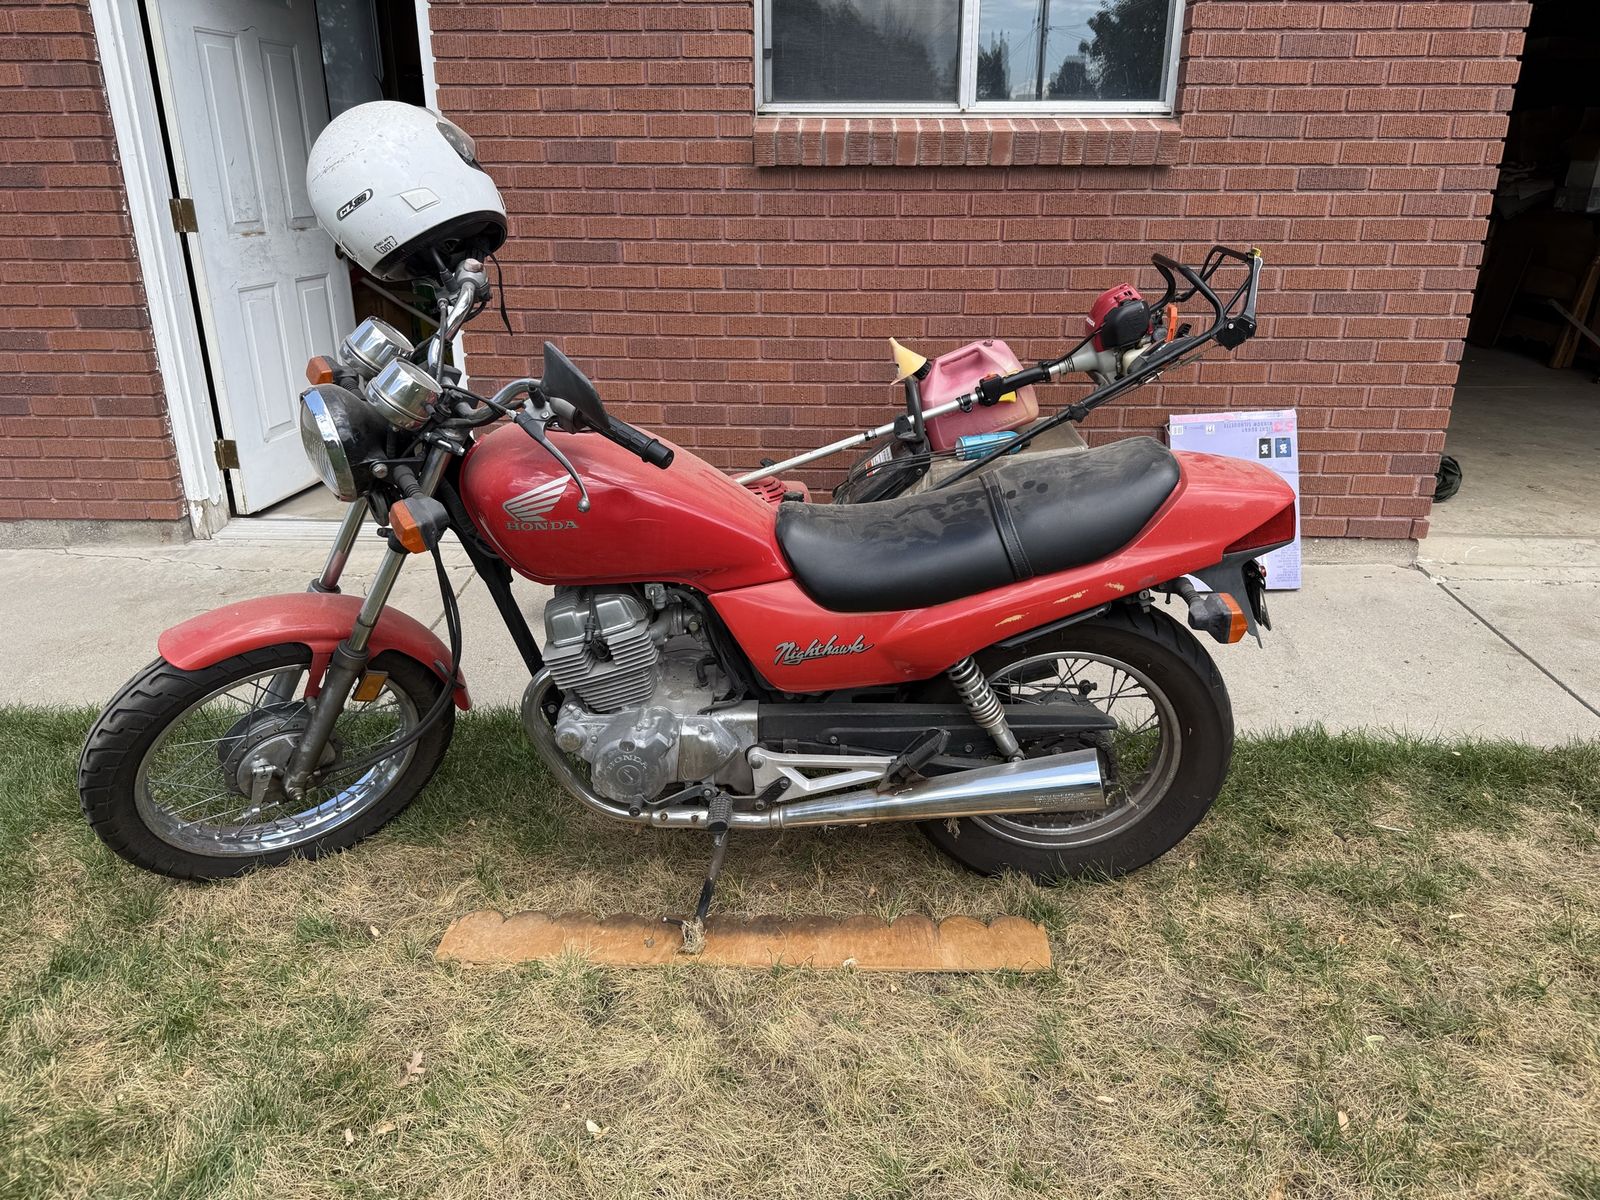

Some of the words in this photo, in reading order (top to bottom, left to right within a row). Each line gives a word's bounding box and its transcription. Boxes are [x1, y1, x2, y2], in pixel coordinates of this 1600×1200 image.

[380, 241, 394, 253] DOT
[505, 520, 578, 531] HONDA
[773, 634, 875, 665] Nighthawk
[606, 754, 648, 770] HONDA
